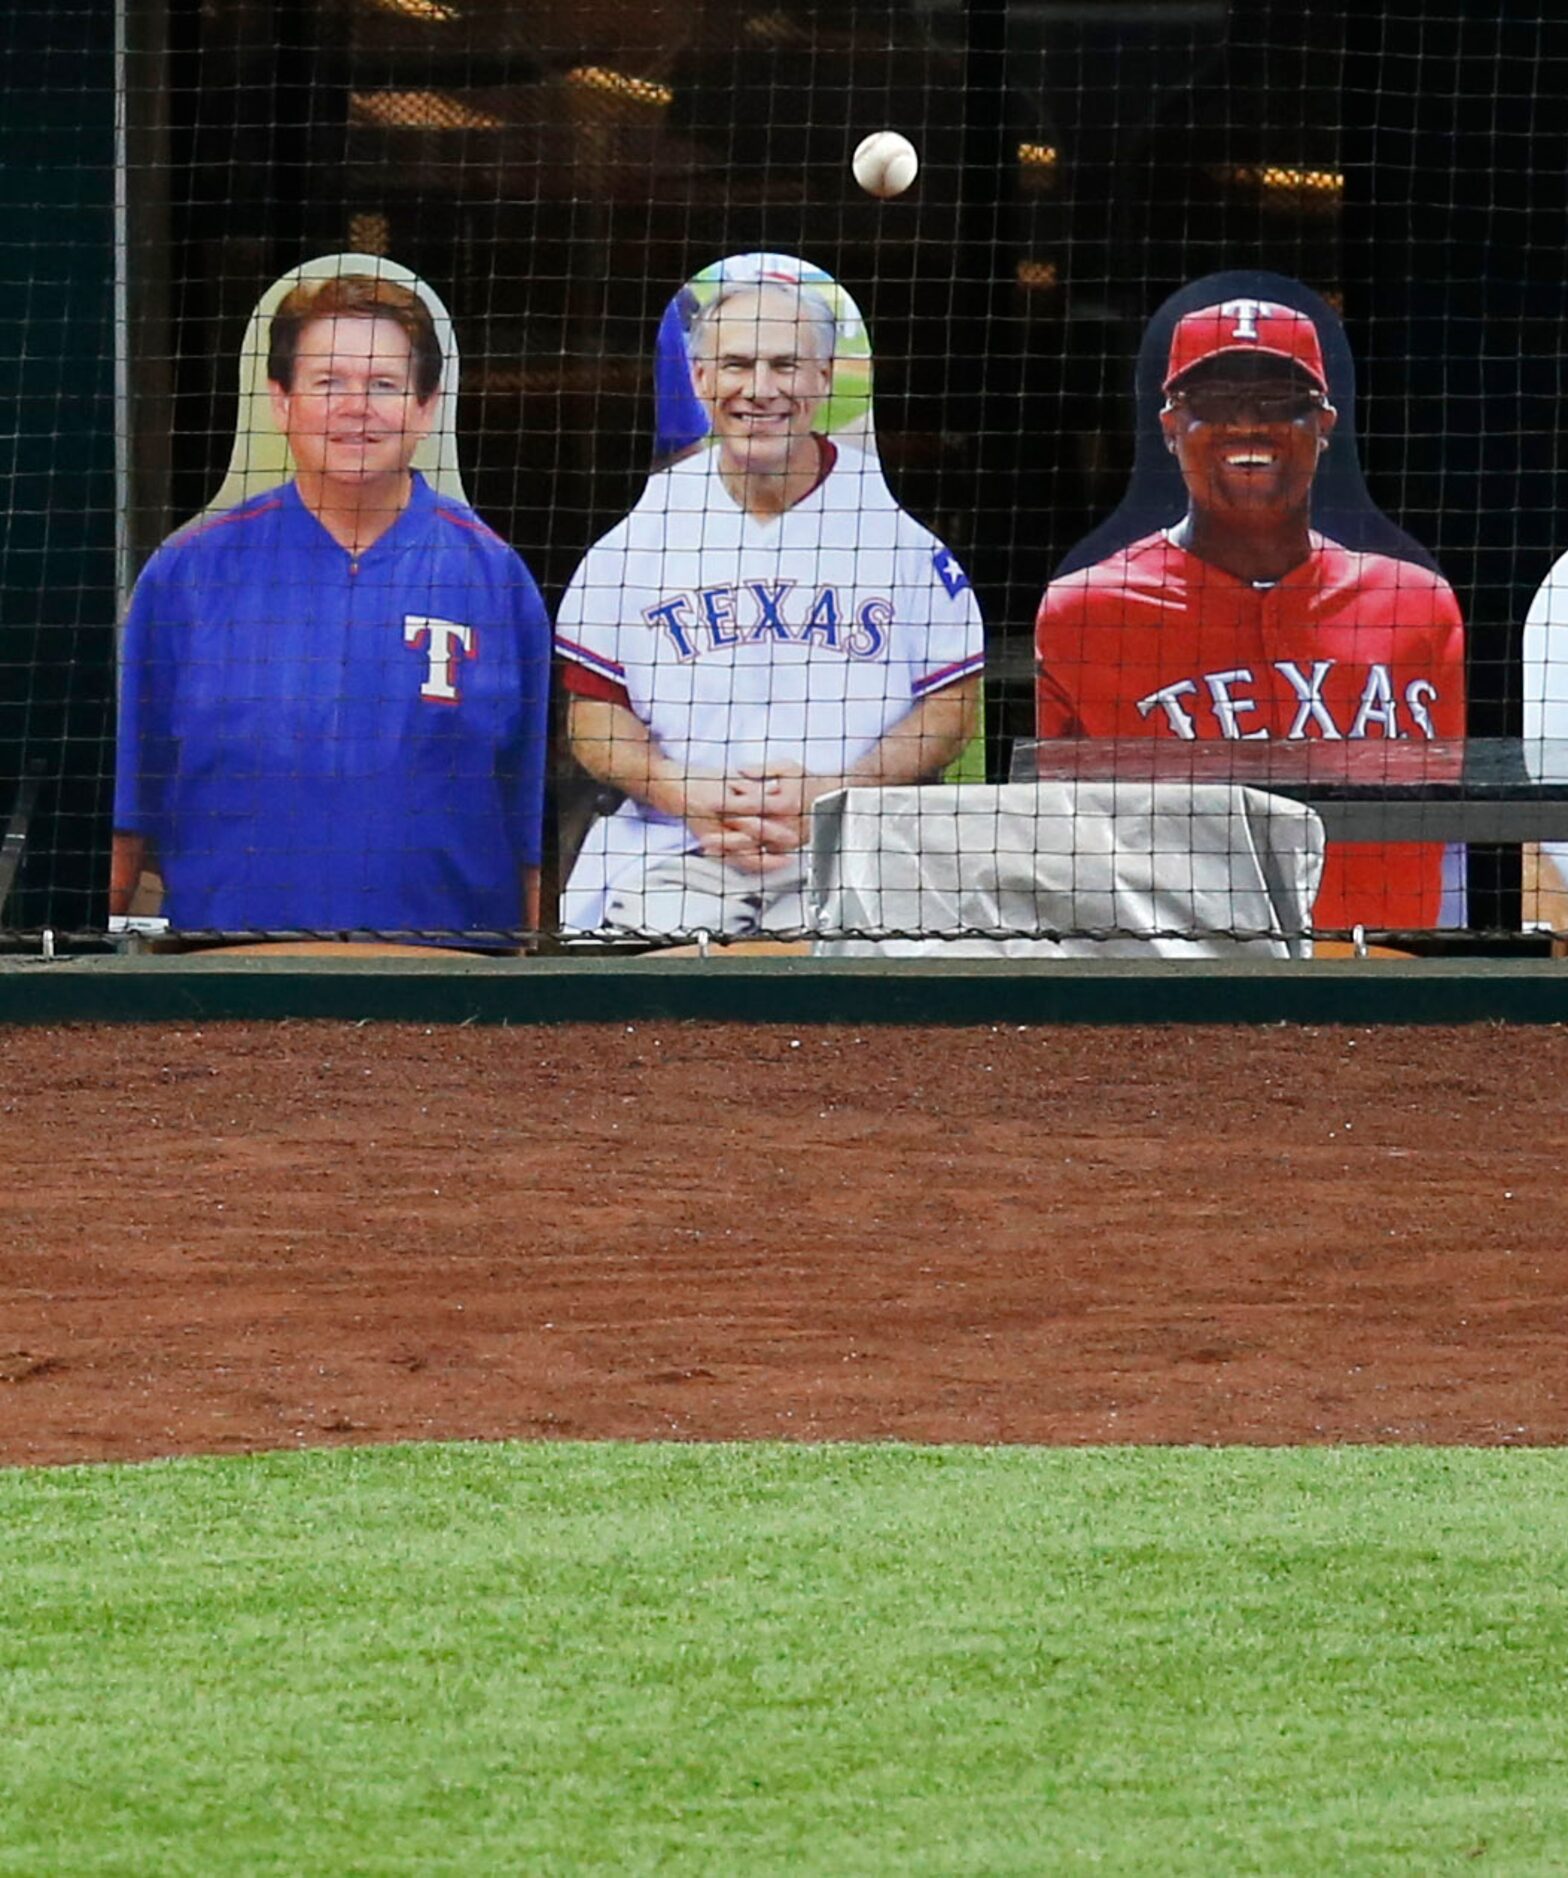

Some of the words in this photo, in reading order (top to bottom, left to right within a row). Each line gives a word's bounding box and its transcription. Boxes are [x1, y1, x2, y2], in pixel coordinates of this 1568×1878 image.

[1220, 298, 1273, 340] T
[403, 613, 477, 706] T
[641, 578, 895, 663] TEXAS
[1135, 660, 1438, 740] TEXAS
